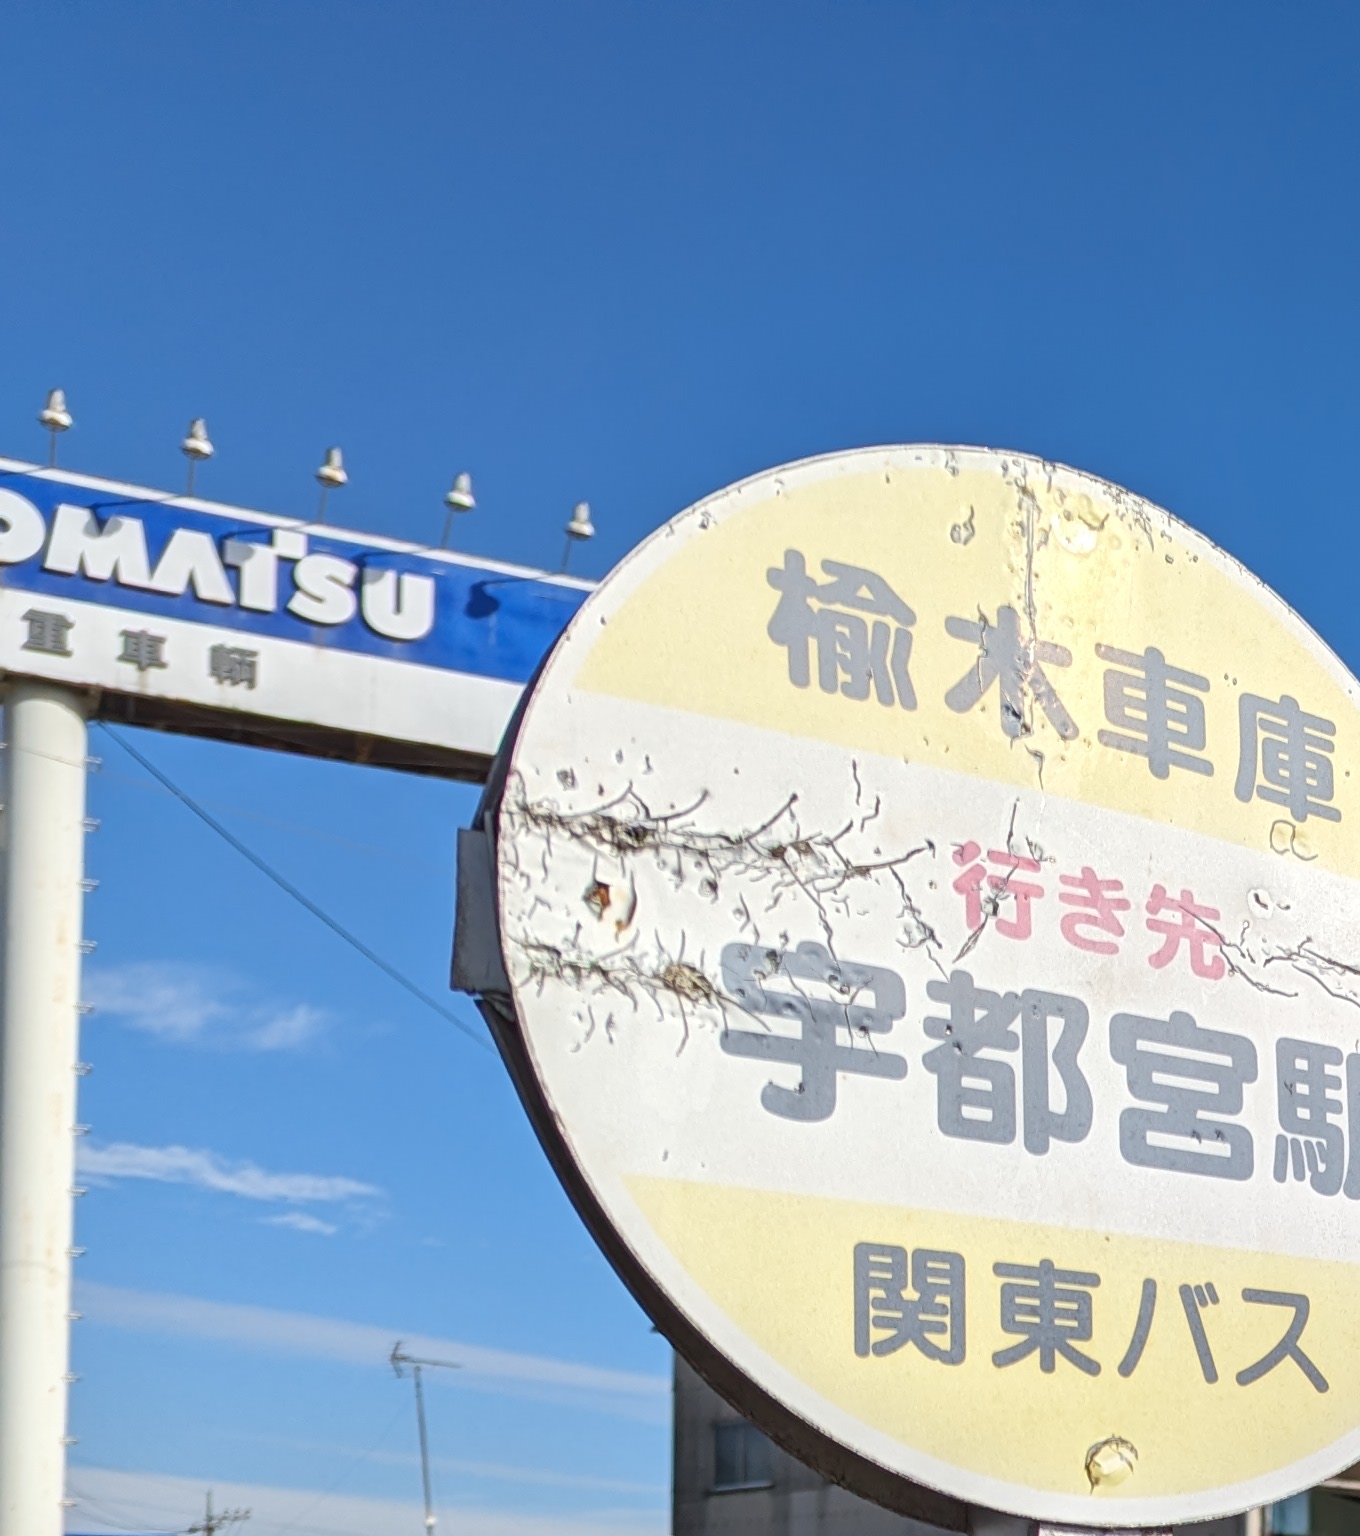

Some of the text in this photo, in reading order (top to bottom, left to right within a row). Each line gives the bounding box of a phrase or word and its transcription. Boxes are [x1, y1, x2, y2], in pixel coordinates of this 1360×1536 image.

[766, 548, 1343, 826] 楡木車庫
[951, 838, 1230, 982] 行き先
[851, 1241, 1329, 1394] 関東バス
